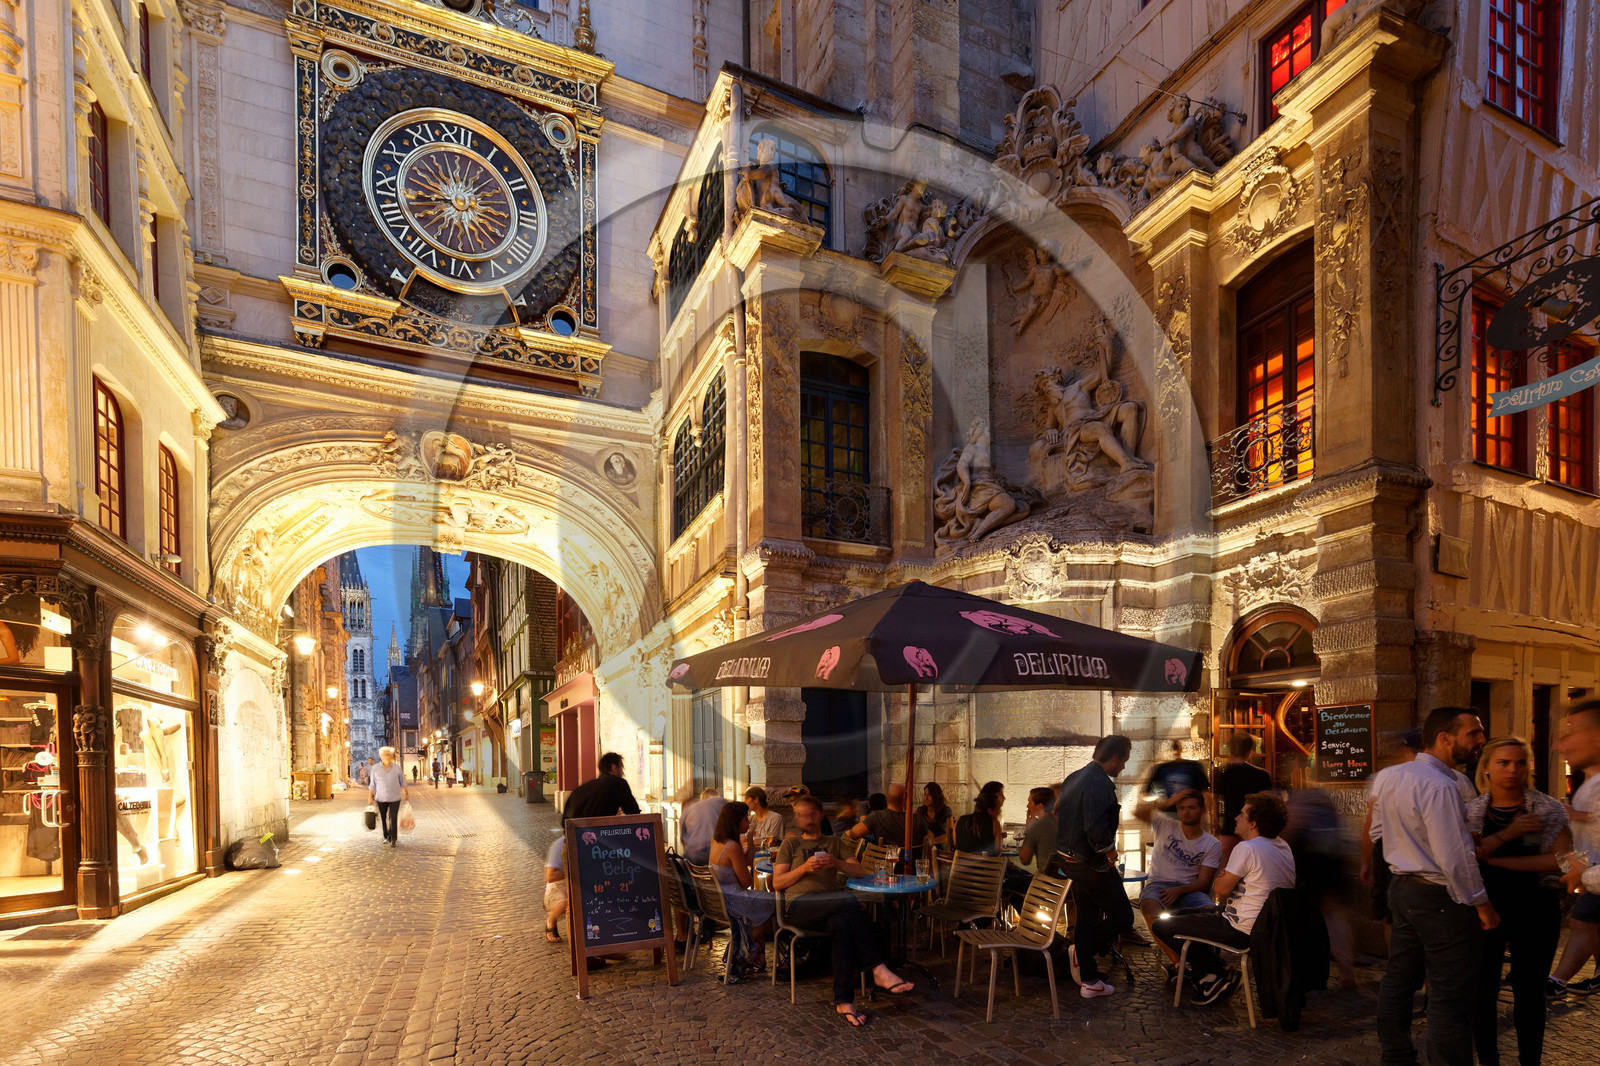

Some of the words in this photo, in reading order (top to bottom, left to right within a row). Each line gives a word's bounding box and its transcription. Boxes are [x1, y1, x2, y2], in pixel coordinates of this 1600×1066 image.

[405, 123, 436, 147] XI
[439, 123, 473, 148] XII
[382, 140, 406, 165] X
[487, 147, 498, 162] I
[375, 169, 396, 197] IX
[508, 177, 528, 191] II
[381, 203, 409, 240] VIII
[520, 210, 538, 230] III
[407, 238, 437, 267] VII
[508, 236, 533, 263] IIII
[449, 258, 476, 280] VI
[489, 260, 507, 278] V
[714, 656, 772, 680] DELIRIUM
[1013, 652, 1111, 680] DELIRIUM
[1321, 711, 1371, 722] Bienvenue
